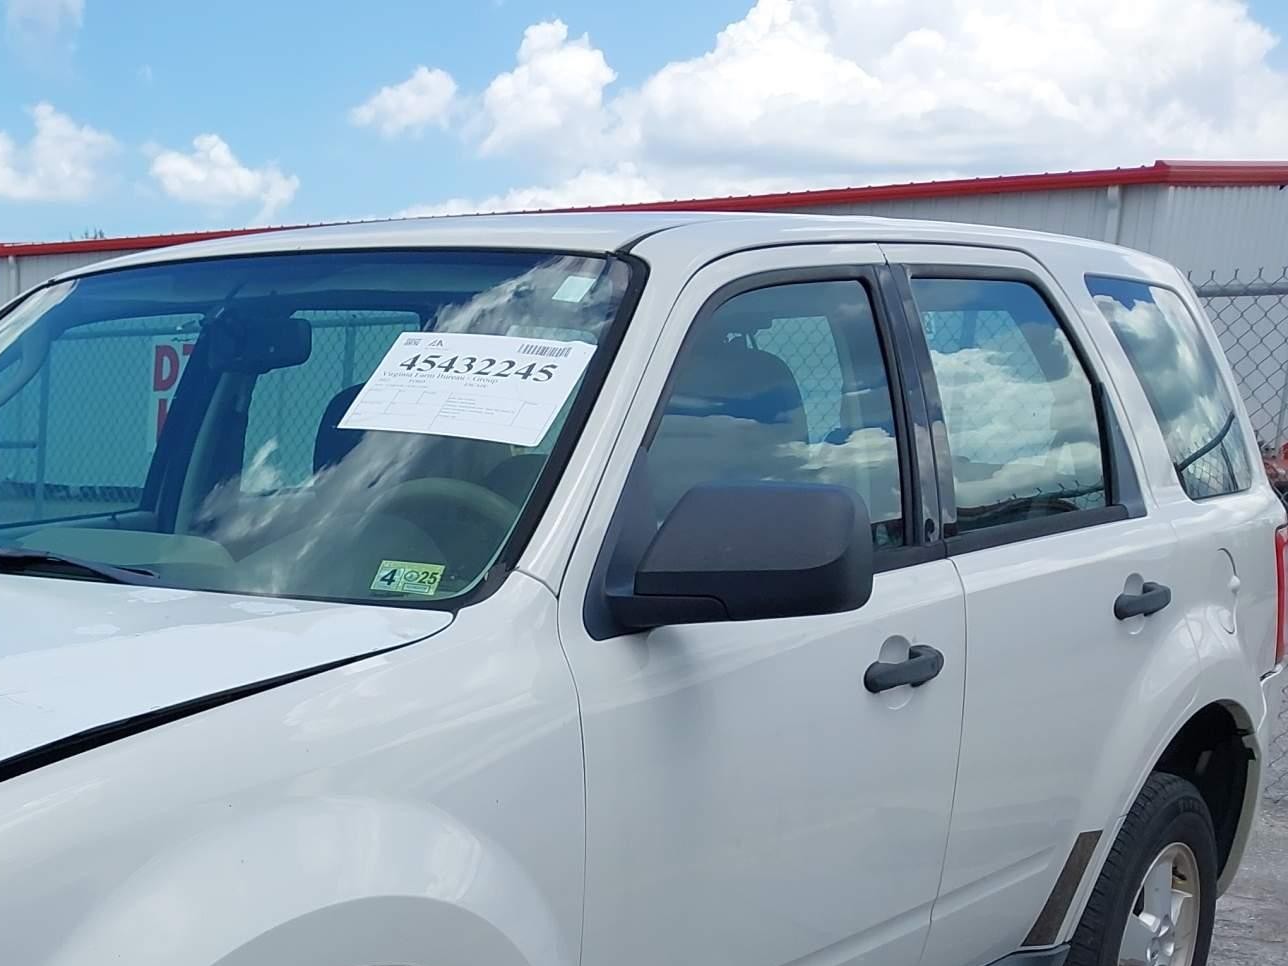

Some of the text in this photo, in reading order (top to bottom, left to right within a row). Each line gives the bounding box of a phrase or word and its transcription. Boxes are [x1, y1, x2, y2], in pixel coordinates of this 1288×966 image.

[399, 353, 558, 383] 45432245
[380, 568, 439, 586] 4 25
